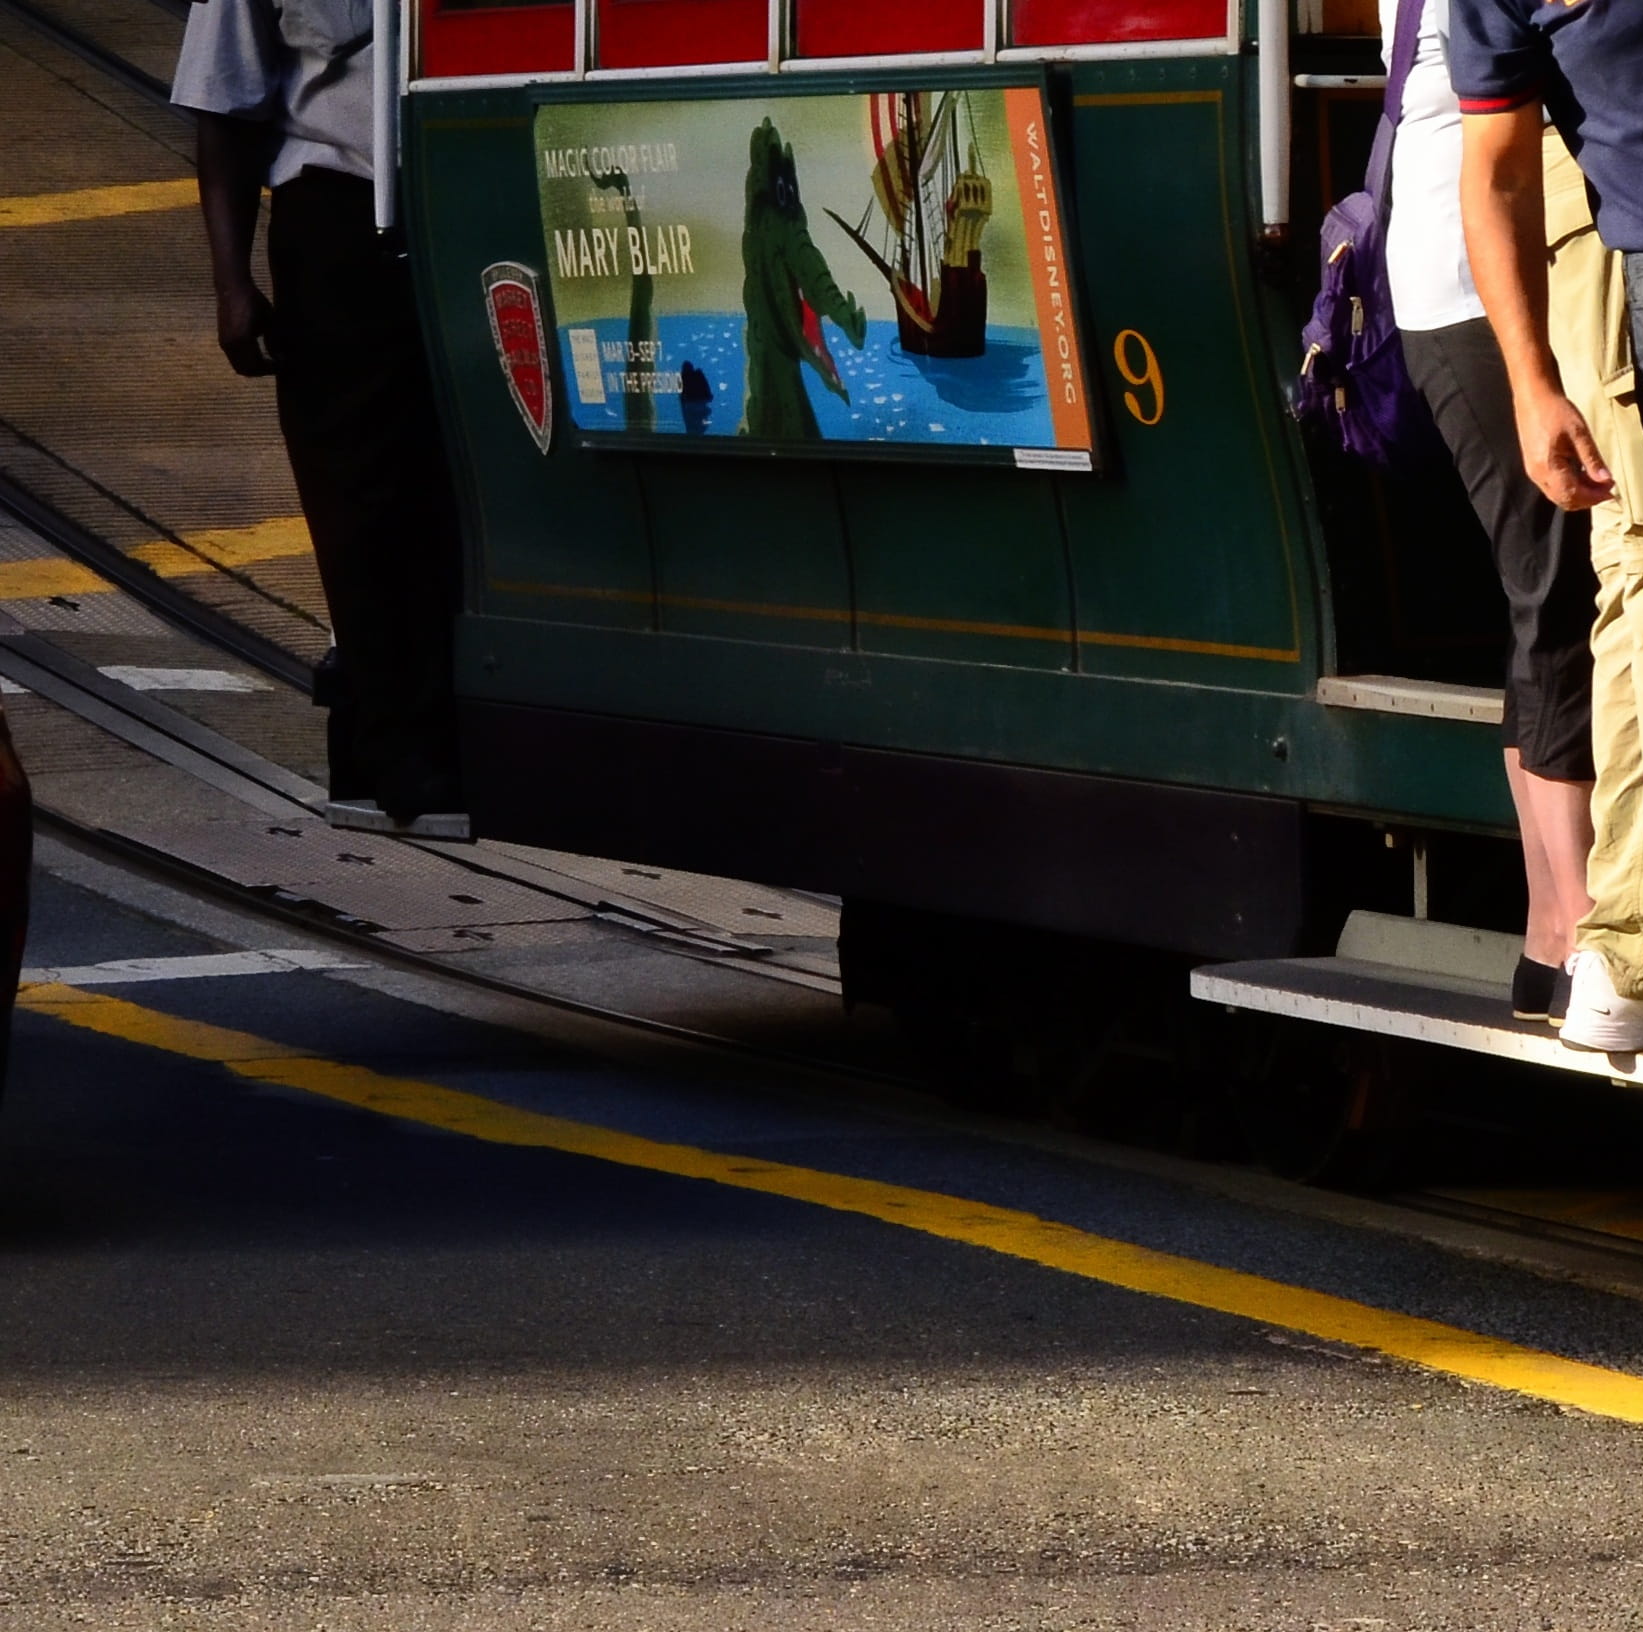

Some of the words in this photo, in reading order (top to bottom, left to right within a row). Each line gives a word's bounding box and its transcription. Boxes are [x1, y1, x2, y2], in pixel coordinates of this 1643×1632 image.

[545, 148, 590, 178] MAGIC
[591, 144, 638, 179] COLOR
[554, 227, 619, 278] MARY
[627, 225, 694, 275] BLAIR
[1114, 329, 1164, 425] 9
